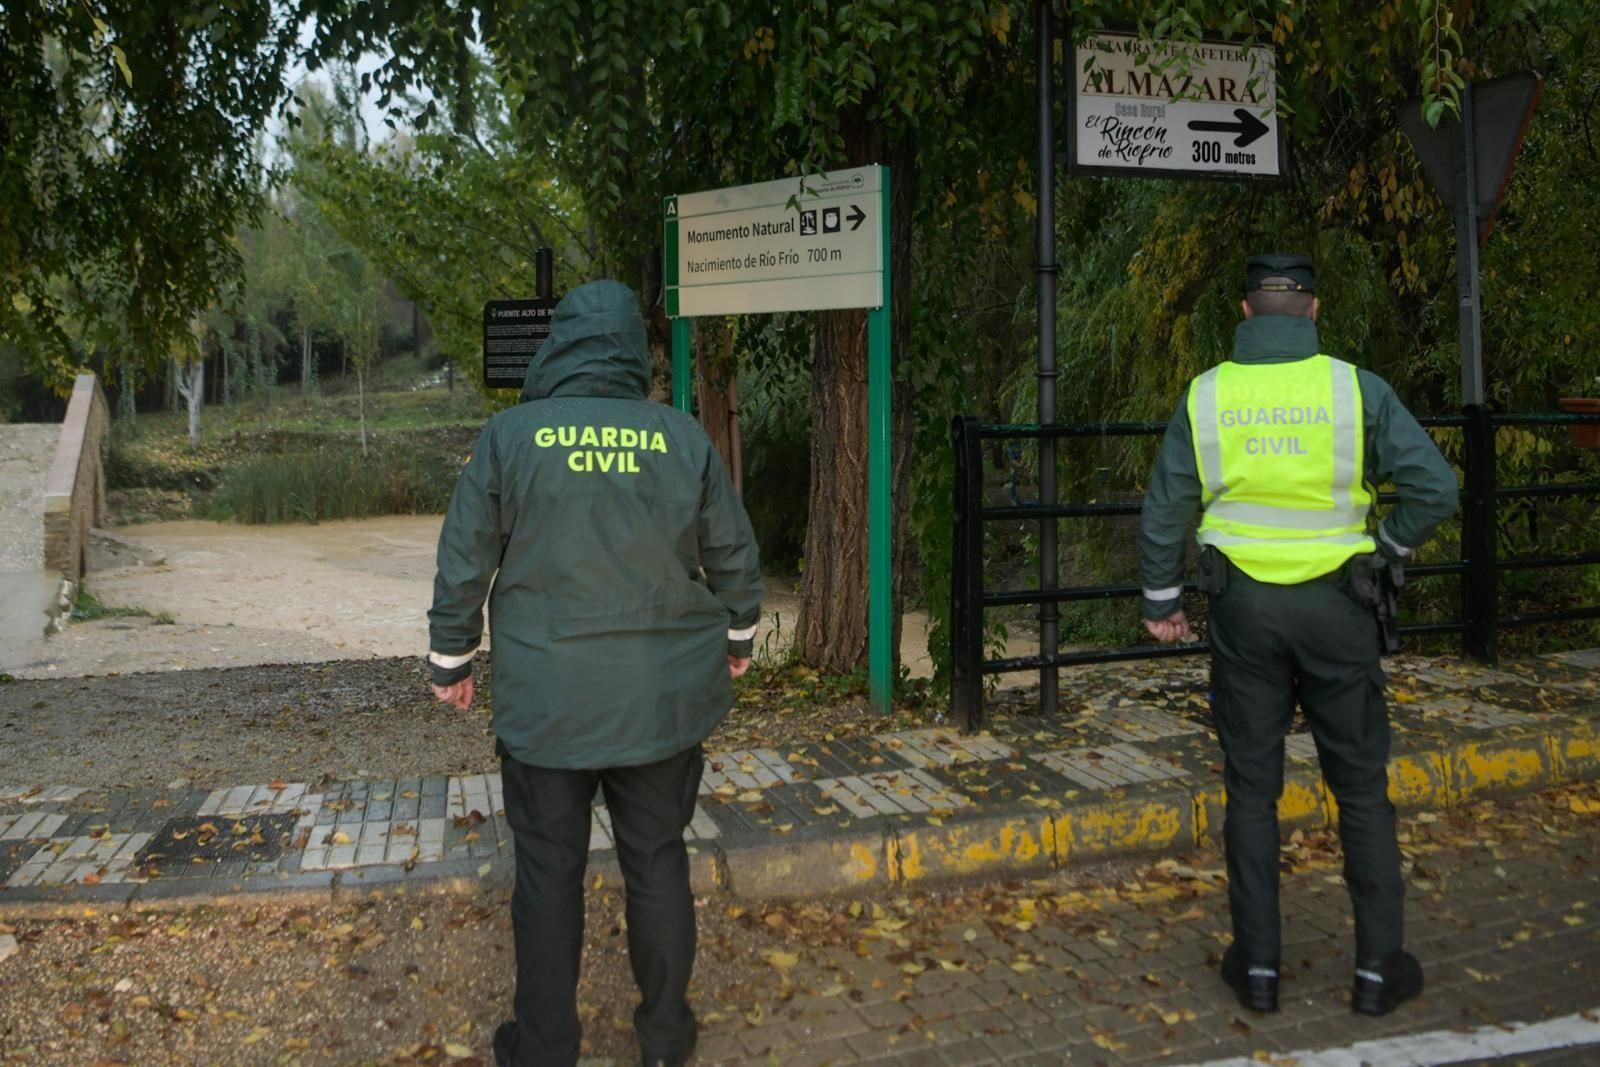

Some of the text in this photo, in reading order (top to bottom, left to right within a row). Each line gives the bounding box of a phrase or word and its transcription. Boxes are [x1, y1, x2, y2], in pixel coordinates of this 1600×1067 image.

[1082, 68, 1258, 104] ALMAZARA
[1085, 114, 1168, 145] El Rincón
[1098, 144, 1113, 159] de
[1192, 140, 1256, 165] 300 metros
[687, 217, 795, 244] Monumento Natural
[687, 247, 842, 273] Nacimiento de Río Frío 700 m
[498, 310, 520, 318] PUENTE
[521, 309, 536, 317] ALTO
[537, 308, 546, 316] DE
[1220, 405, 1331, 428] GUARDIA
[534, 425, 668, 454] GUARDIA
[1245, 436, 1308, 455] CIVIL
[567, 450, 640, 473] CIVIL
